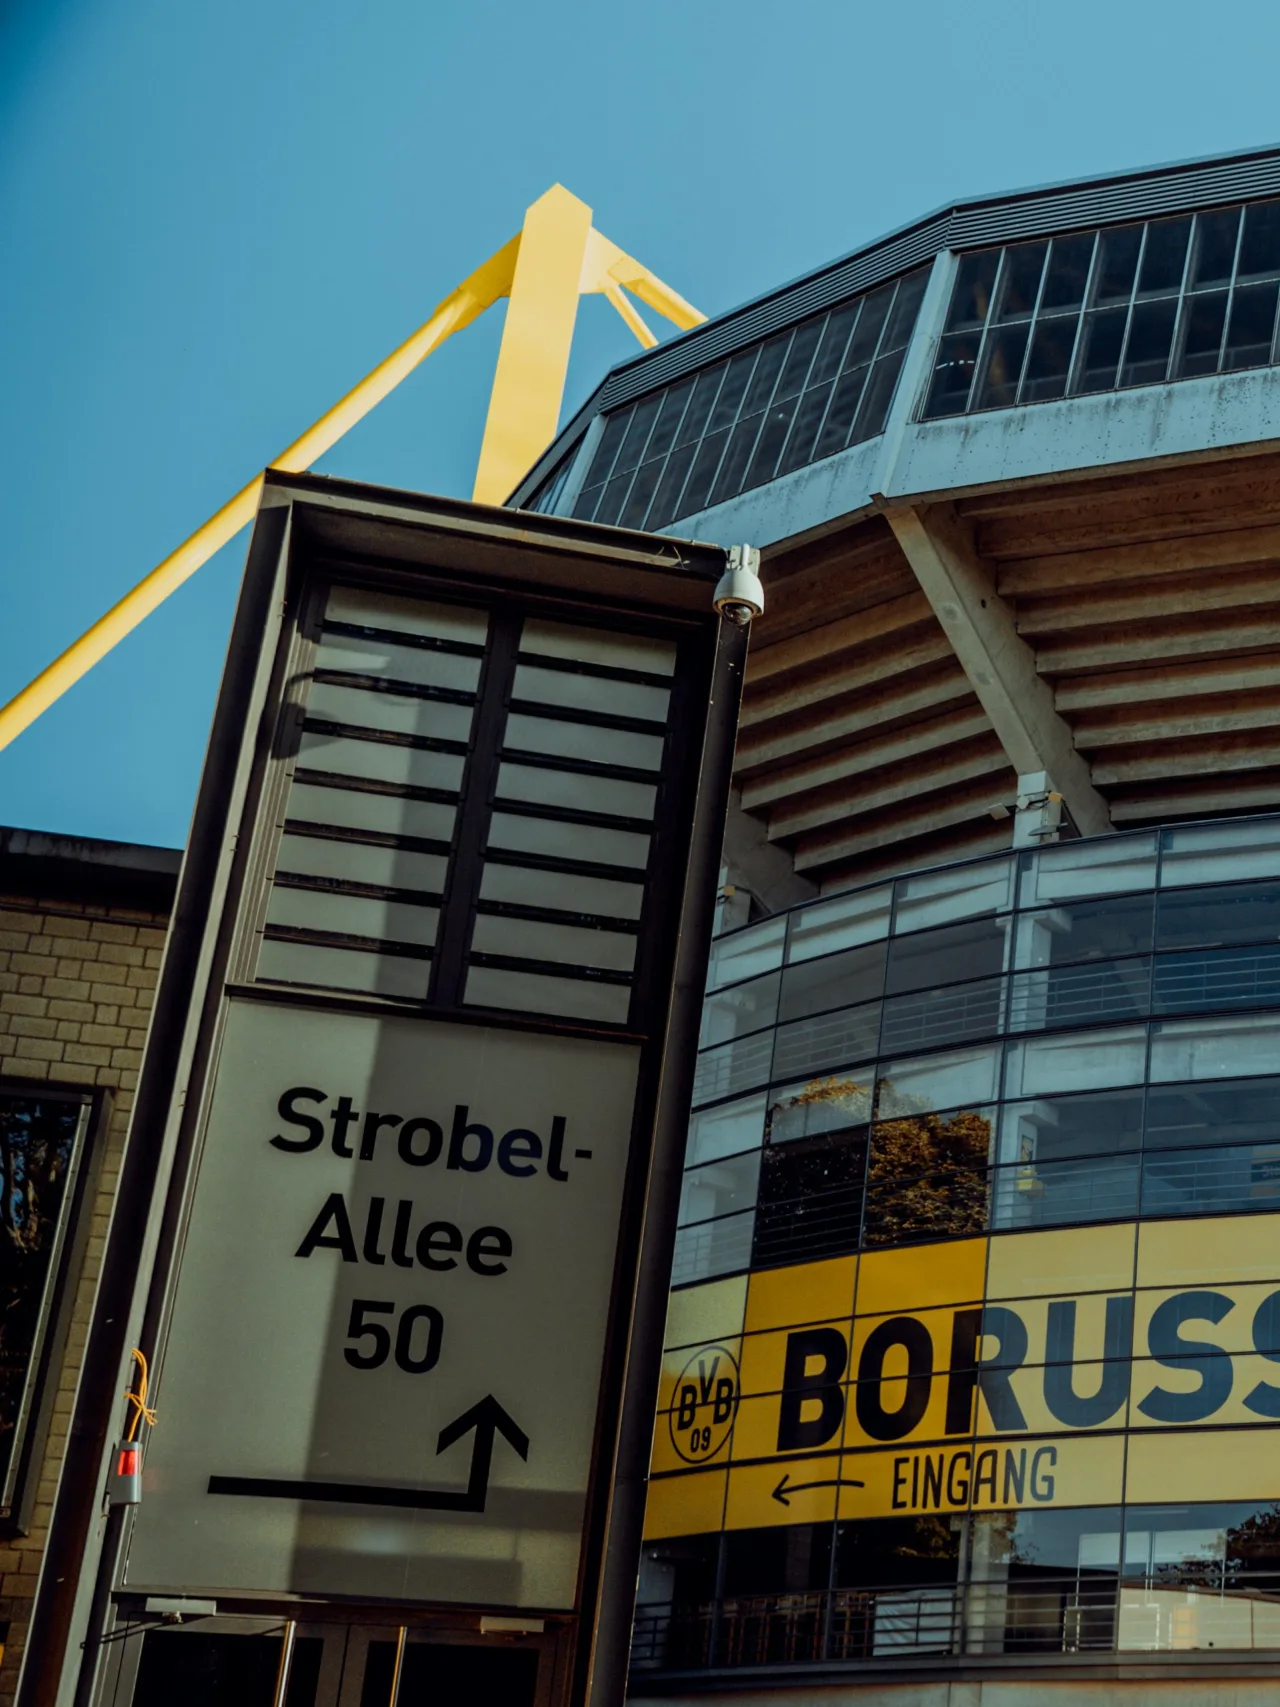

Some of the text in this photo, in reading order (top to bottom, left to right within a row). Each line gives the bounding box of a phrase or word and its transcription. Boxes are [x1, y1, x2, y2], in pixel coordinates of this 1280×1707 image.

[269, 1086, 593, 1182] Strobel-
[294, 1192, 513, 1276] Allee
[343, 1298, 444, 1374] 50
[677, 1356, 734, 1431] BVB
[690, 1425, 712, 1453] 09
[891, 1446, 1057, 1510] EINGANG
